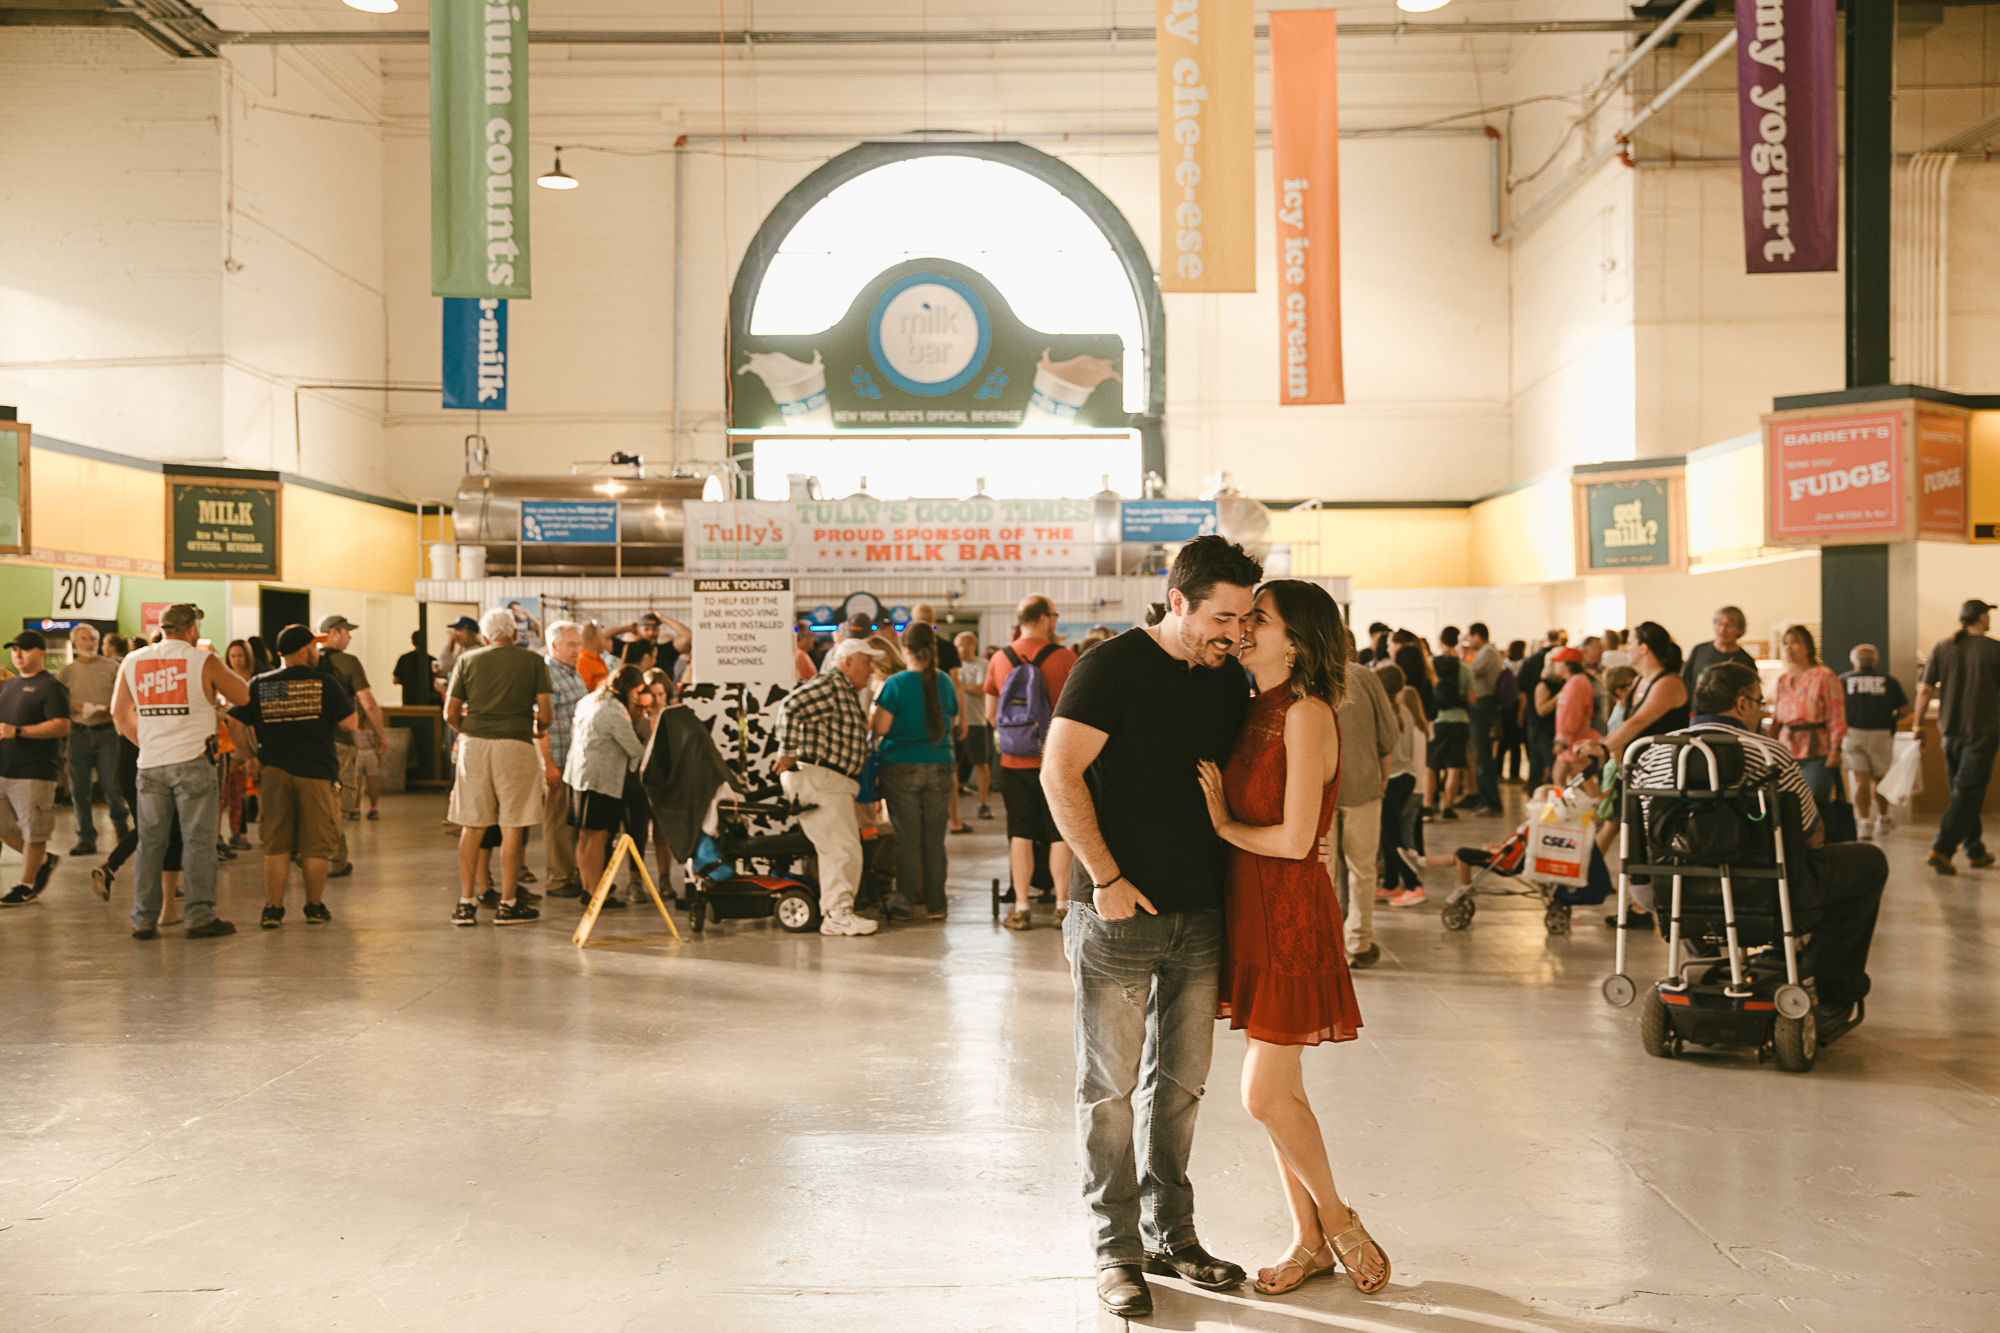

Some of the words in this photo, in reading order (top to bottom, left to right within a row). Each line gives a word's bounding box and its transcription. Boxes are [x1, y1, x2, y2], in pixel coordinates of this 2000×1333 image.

[485, 0, 521, 105] ium
[1172, 58, 1209, 280] che-e-ese
[1750, 83, 1796, 263] yogurt
[485, 117, 520, 286] counts
[1278, 178, 1309, 230] icy
[1285, 238, 1310, 285] ice
[900, 303, 960, 335] milk
[907, 335, 953, 365] bar
[1286, 292, 1309, 399] cream
[1783, 426, 1890, 447] BARRETT'S
[1788, 460, 1891, 501] FUDGE
[1923, 466, 1962, 494] FUDGE
[198, 499, 254, 526] MILK
[797, 502, 908, 524] TULLY'S
[915, 502, 994, 523] GOOD
[1000, 501, 1091, 522] TIMES
[1613, 498, 1643, 528] got
[703, 519, 783, 546] Tully's
[814, 529, 885, 542] PROUD
[894, 528, 991, 541] SPONSOR
[1000, 528, 1025, 540] OF
[1034, 528, 1073, 540] THE
[1603, 519, 1659, 548] milk?
[866, 544, 944, 562] MILK
[959, 544, 1022, 561] BAR
[60, 576, 86, 610] 20
[699, 581, 730, 591] MILK
[732, 580, 784, 590] TOKENS
[703, 609, 721, 617] LINE
[704, 596, 716, 605] TO
[718, 596, 738, 605] HELP
[740, 596, 760, 605] KEEP
[762, 596, 778, 605] THE
[699, 621, 712, 629] WE
[714, 621, 737, 629] HAVE
[740, 620, 784, 629] INSTALLED
[727, 633, 756, 641] TOKEN
[716, 645, 767, 653] DISPENSING
[142, 666, 178, 697] PSE
[1846, 675, 1886, 696] FIRE
